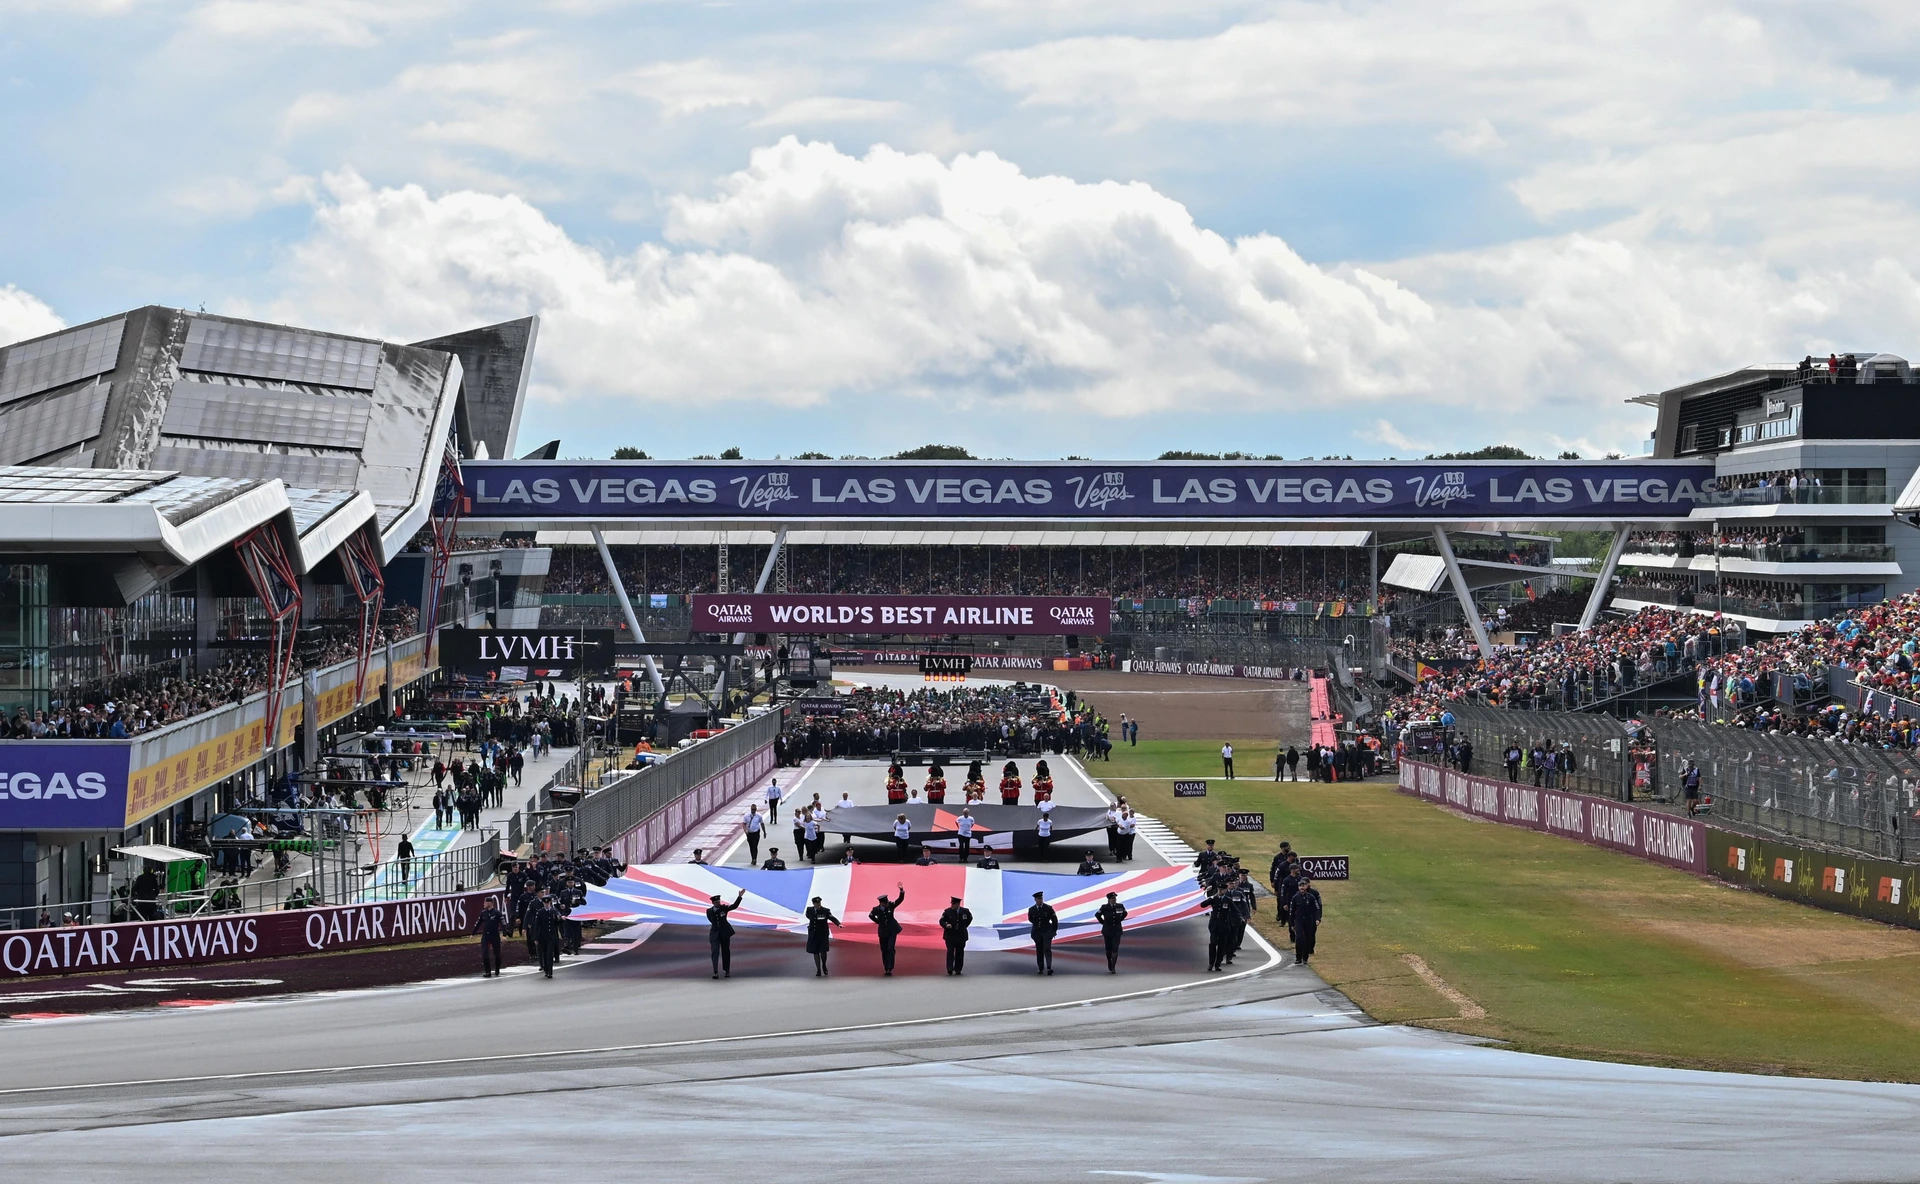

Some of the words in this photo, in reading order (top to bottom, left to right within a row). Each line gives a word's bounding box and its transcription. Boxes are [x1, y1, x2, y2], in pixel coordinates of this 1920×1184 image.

[769, 473, 788, 485] LAS
[1104, 473, 1123, 485] LAS
[1444, 472, 1464, 485] LAS
[477, 479, 560, 503] LAS
[569, 479, 717, 503] VEGAS
[730, 476, 799, 511] Vegas
[812, 479, 896, 503] LAS
[905, 479, 1053, 503] VEGAS
[1066, 476, 1135, 511] Vegas
[1152, 479, 1237, 503] LAS
[1246, 479, 1393, 503] VEGAS
[1406, 476, 1476, 510] Vegas
[1490, 479, 1573, 503] LAS
[708, 604, 752, 617] QATAR
[770, 606, 874, 624] WORLD'S
[881, 606, 936, 624] BEST
[943, 607, 1034, 625] AIRLINE
[1050, 606, 1094, 619] QATAR
[479, 636, 575, 660] LVMH
[925, 658, 966, 669] LVMH
[1001, 657, 1042, 669] AIRWAYS
[1132, 660, 1154, 672] QATAR
[1187, 662, 1208, 675] QATAR
[1175, 782, 1205, 792] QATAR
[1227, 815, 1262, 826] QATAR
[1544, 794, 1561, 829] QATAR
[1590, 803, 1609, 840] QATAR
[1610, 807, 1636, 847] AIRWAYS
[1642, 815, 1665, 856] QATAR
[1666, 821, 1695, 863] AIRWAYS
[1303, 860, 1347, 873] QATAR
[1313, 870, 1347, 878] AIRWAYS
[305, 906, 386, 950] QATAR
[392, 898, 467, 937] AIRWAYS
[3, 930, 121, 975] QATAR
[130, 919, 258, 962] AIRWAYS
